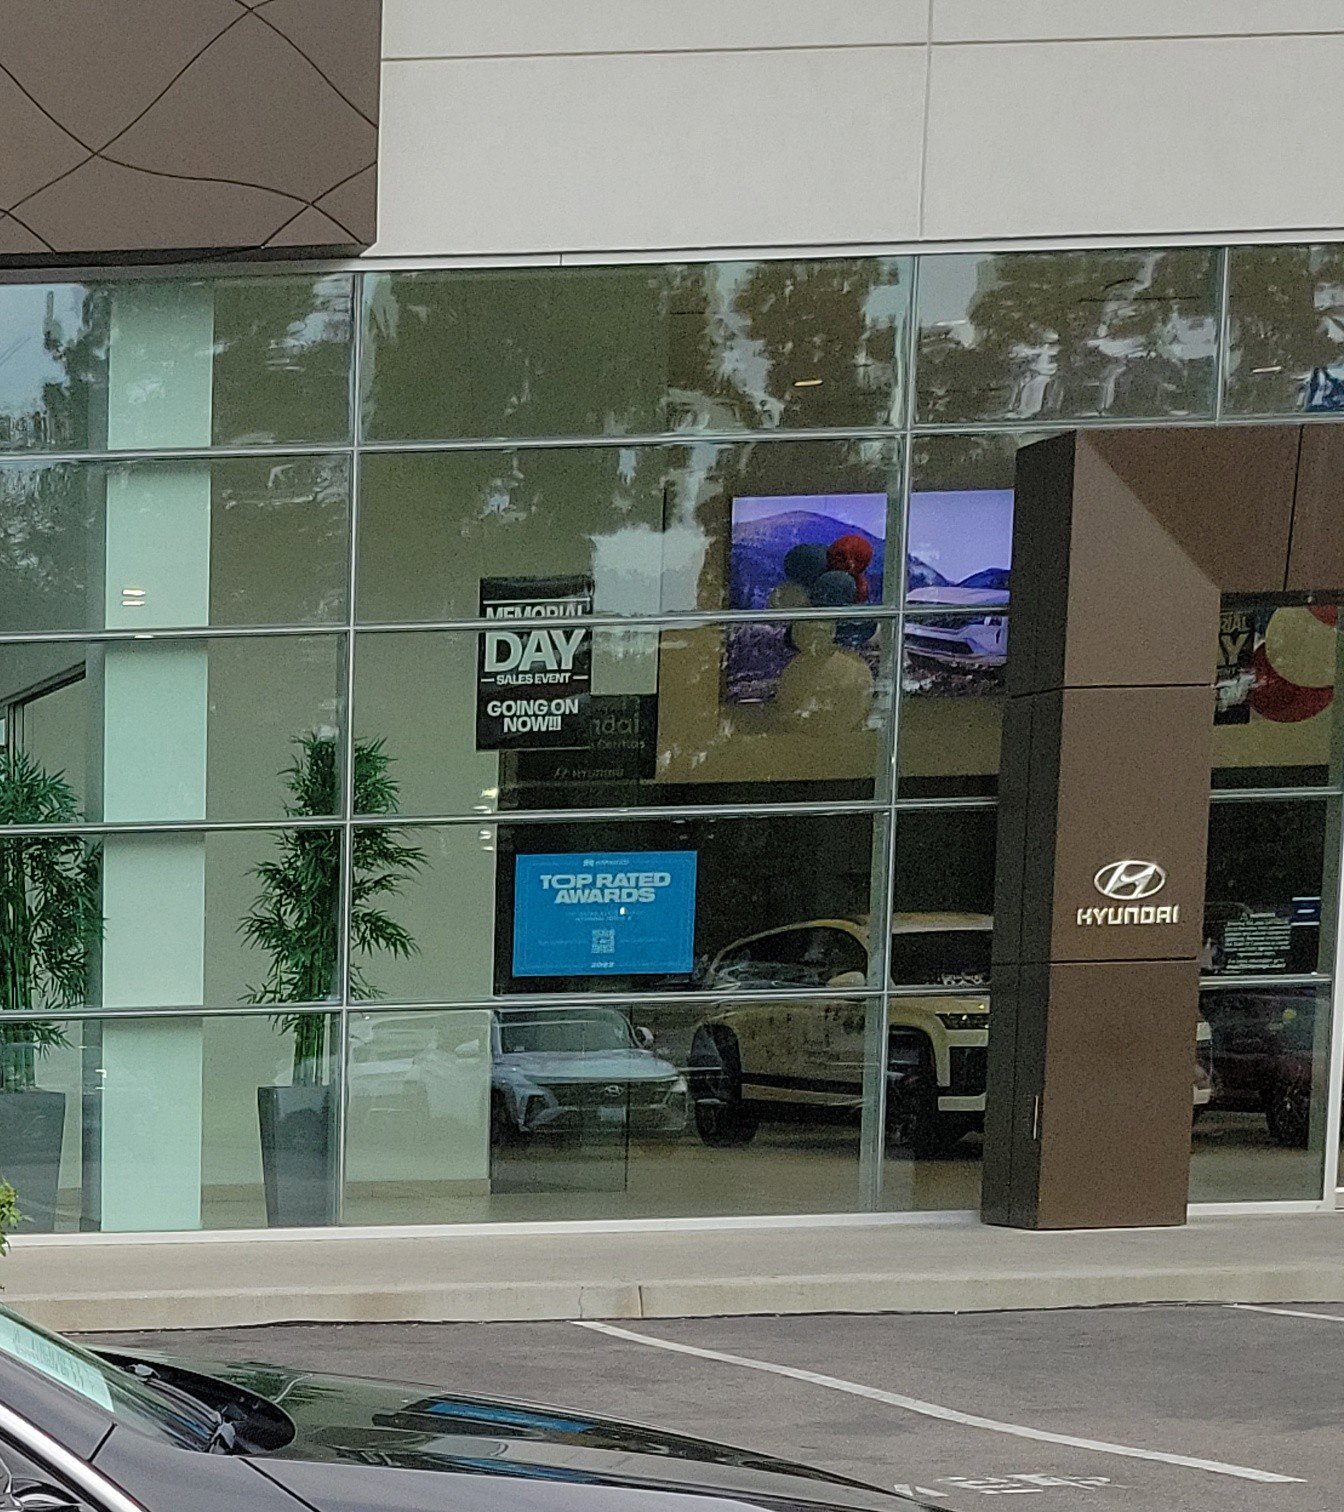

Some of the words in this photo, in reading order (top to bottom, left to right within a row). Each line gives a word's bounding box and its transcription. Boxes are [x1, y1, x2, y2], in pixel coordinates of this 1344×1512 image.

[485, 605, 583, 620] MEMORIAL
[484, 628, 586, 673] DAY
[496, 673, 534, 685] SALES
[534, 672, 572, 684] EVENT
[487, 700, 548, 717] GOING
[550, 699, 579, 715] ON
[540, 874, 593, 890] TOP
[595, 872, 671, 889] RATED
[554, 887, 656, 904] AWARDS
[1076, 904, 1180, 926] HYUNDAI
